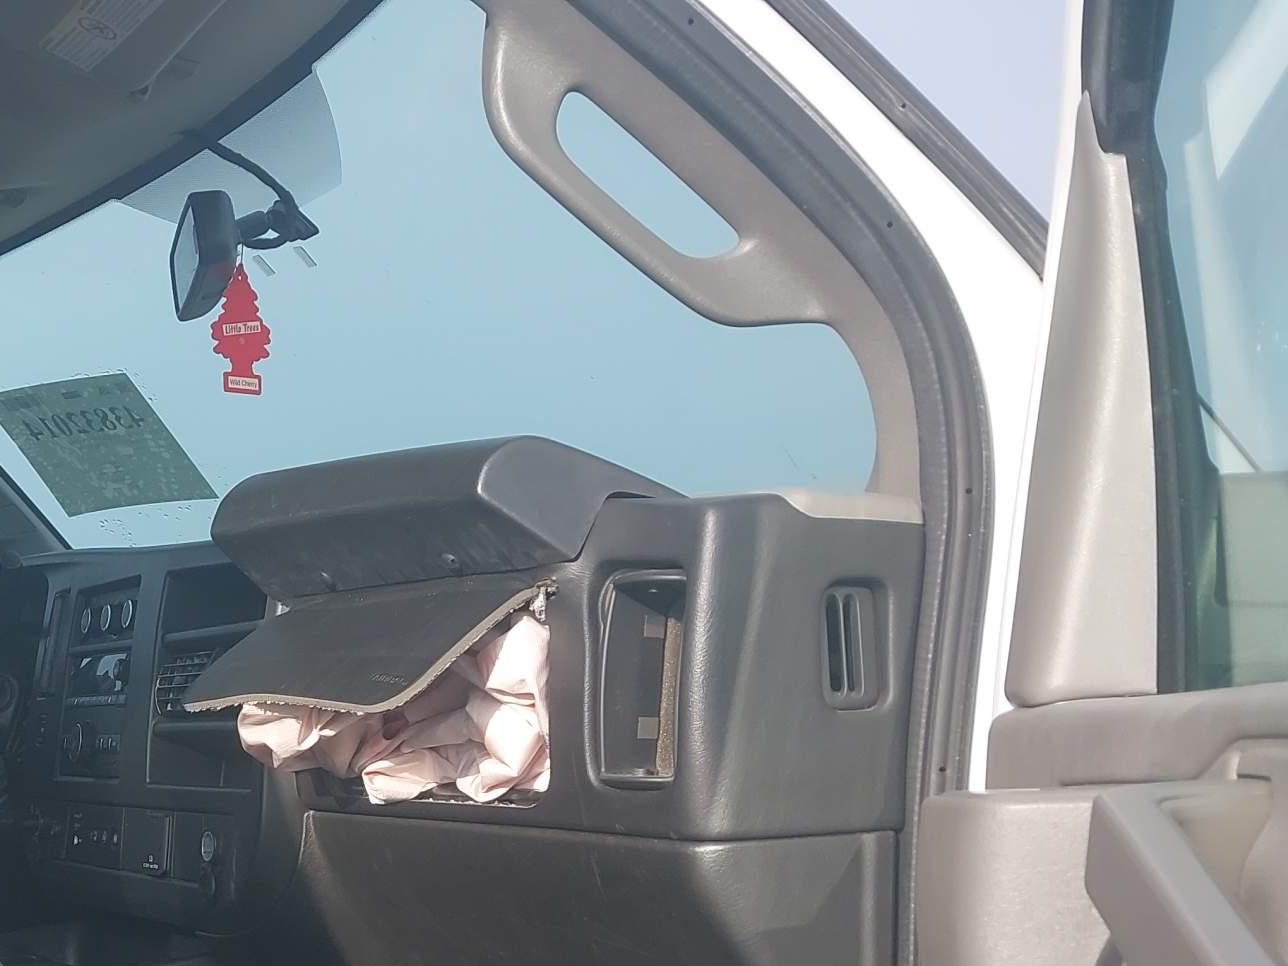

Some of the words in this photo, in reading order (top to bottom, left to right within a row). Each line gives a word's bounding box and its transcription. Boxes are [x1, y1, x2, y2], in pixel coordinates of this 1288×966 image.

[225, 323, 242, 335] Little
[243, 322, 260, 333] Trees
[229, 377, 240, 386] Wild
[241, 378, 258, 389] Cherry
